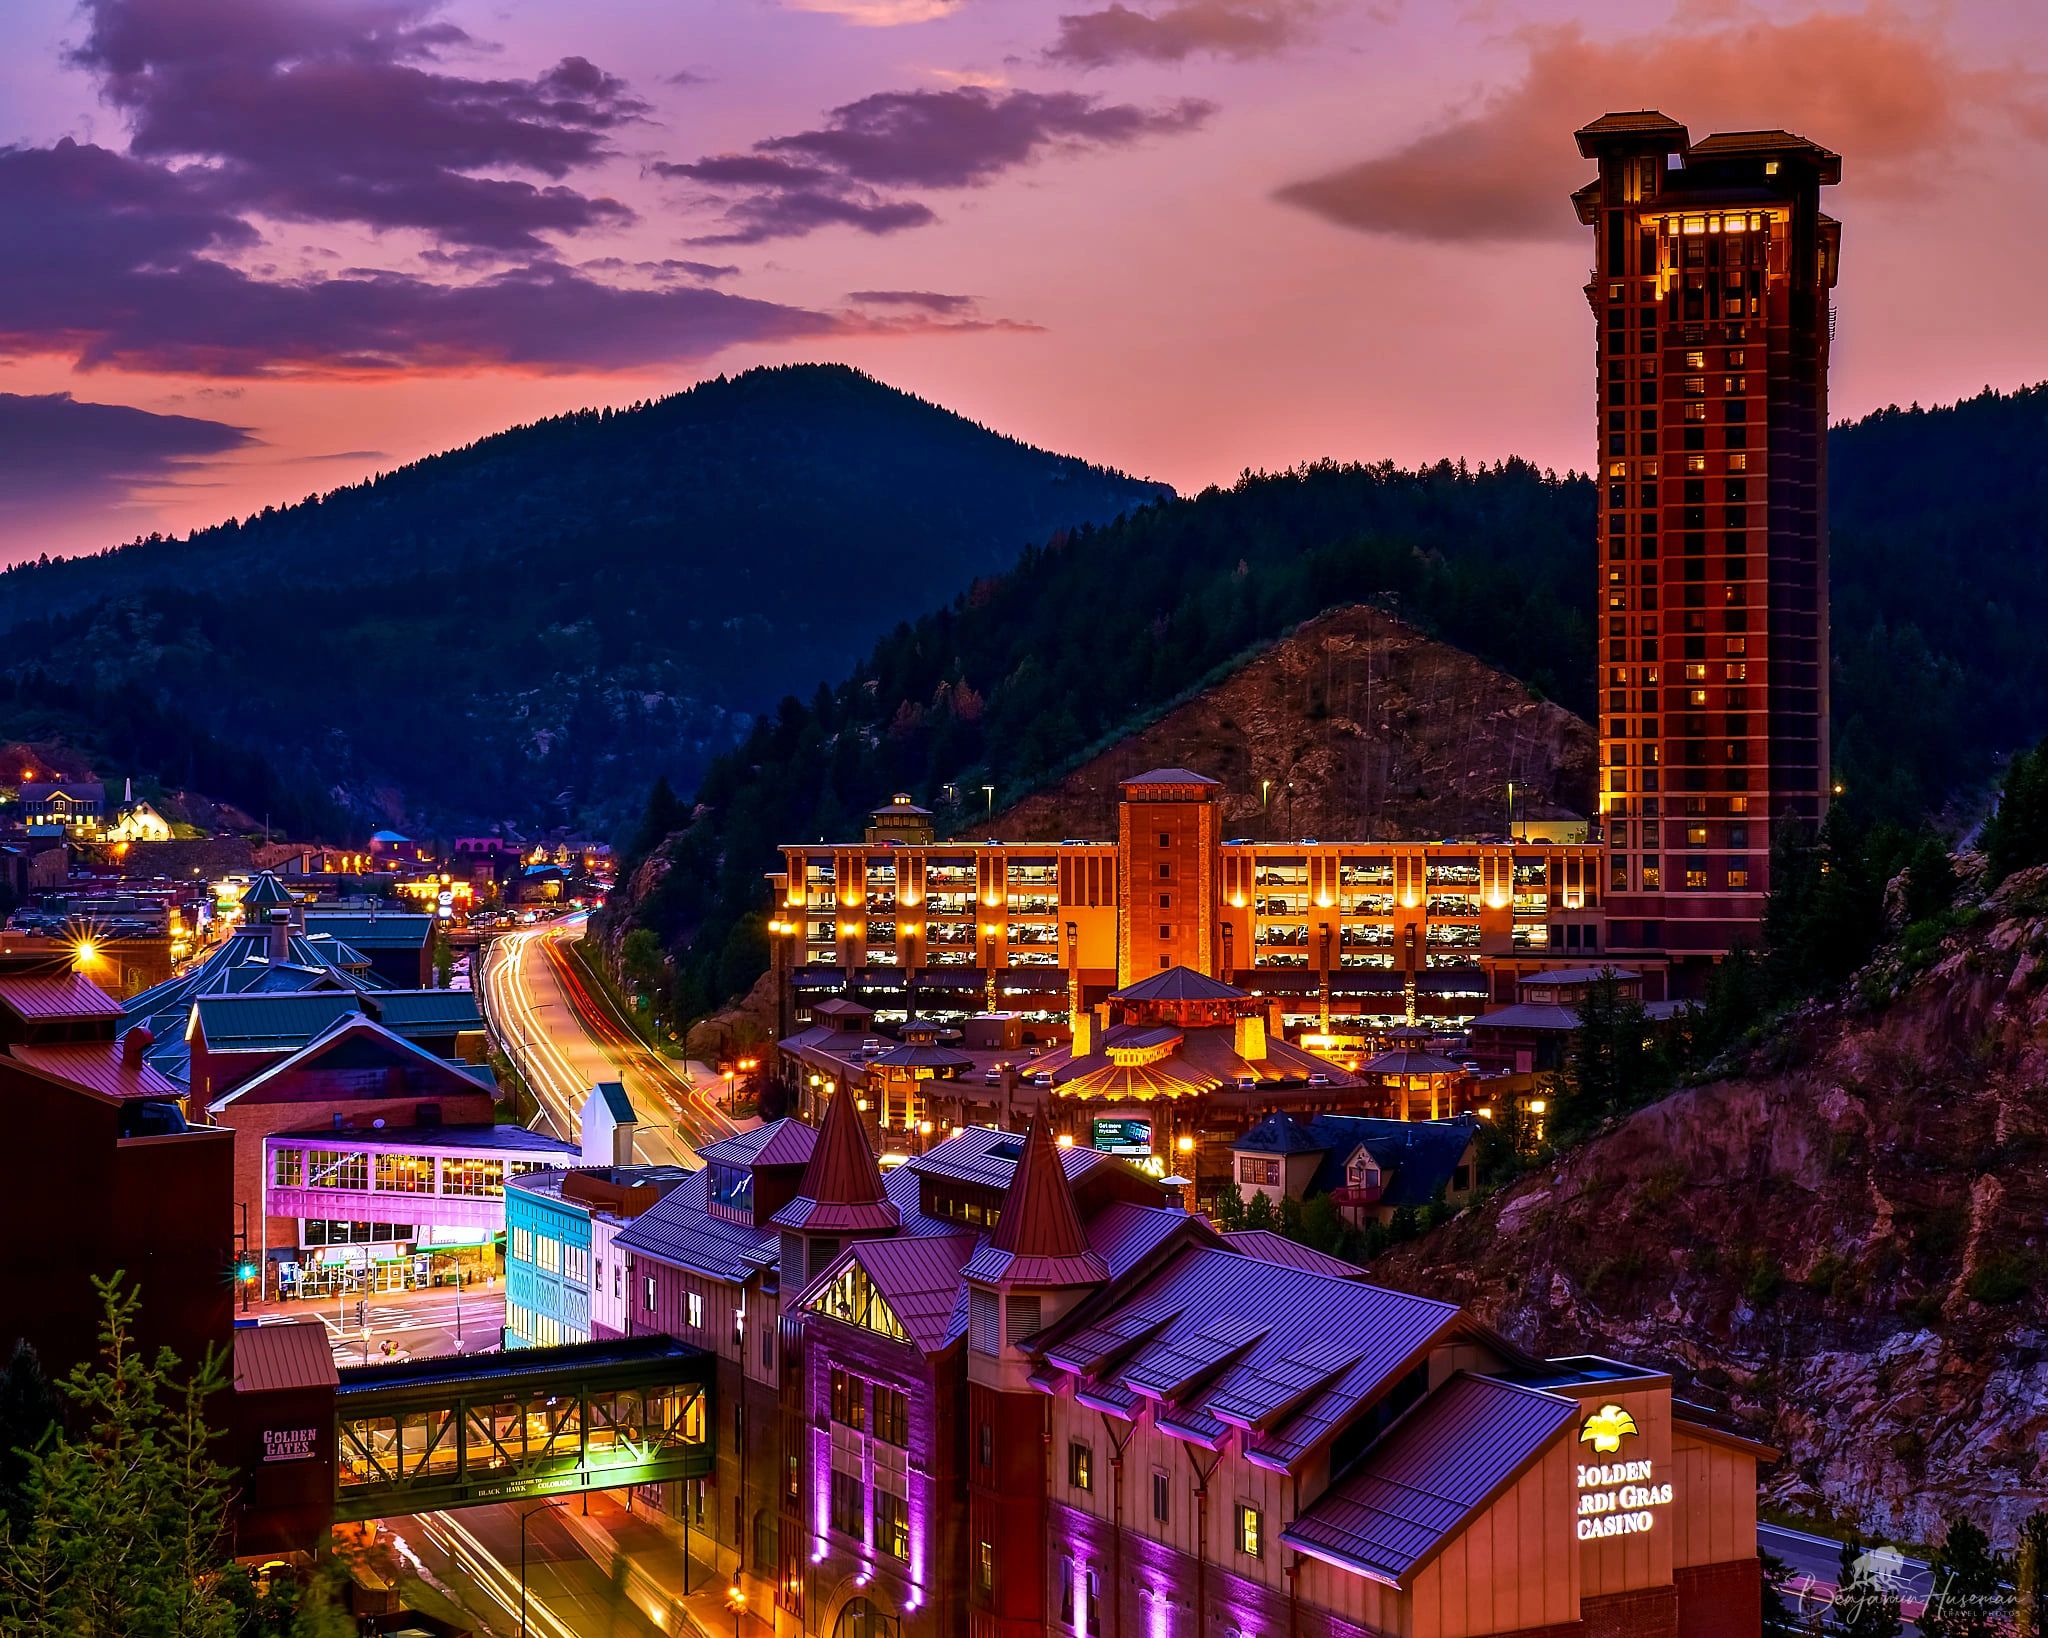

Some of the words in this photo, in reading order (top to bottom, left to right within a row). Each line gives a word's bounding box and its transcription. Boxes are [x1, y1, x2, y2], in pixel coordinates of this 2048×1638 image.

[1122, 1156, 1165, 1178] TAR
[264, 1428, 316, 1443] GOLDEN
[267, 1441, 309, 1455] GATES
[478, 1488, 501, 1497] BLACK
[506, 1485, 526, 1493] HAWK
[537, 1479, 573, 1489] COLORADO
[1577, 1491, 1616, 1514] RDI
[1619, 1484, 1673, 1509] GRAS
[1577, 1511, 1653, 1540] CASINO
